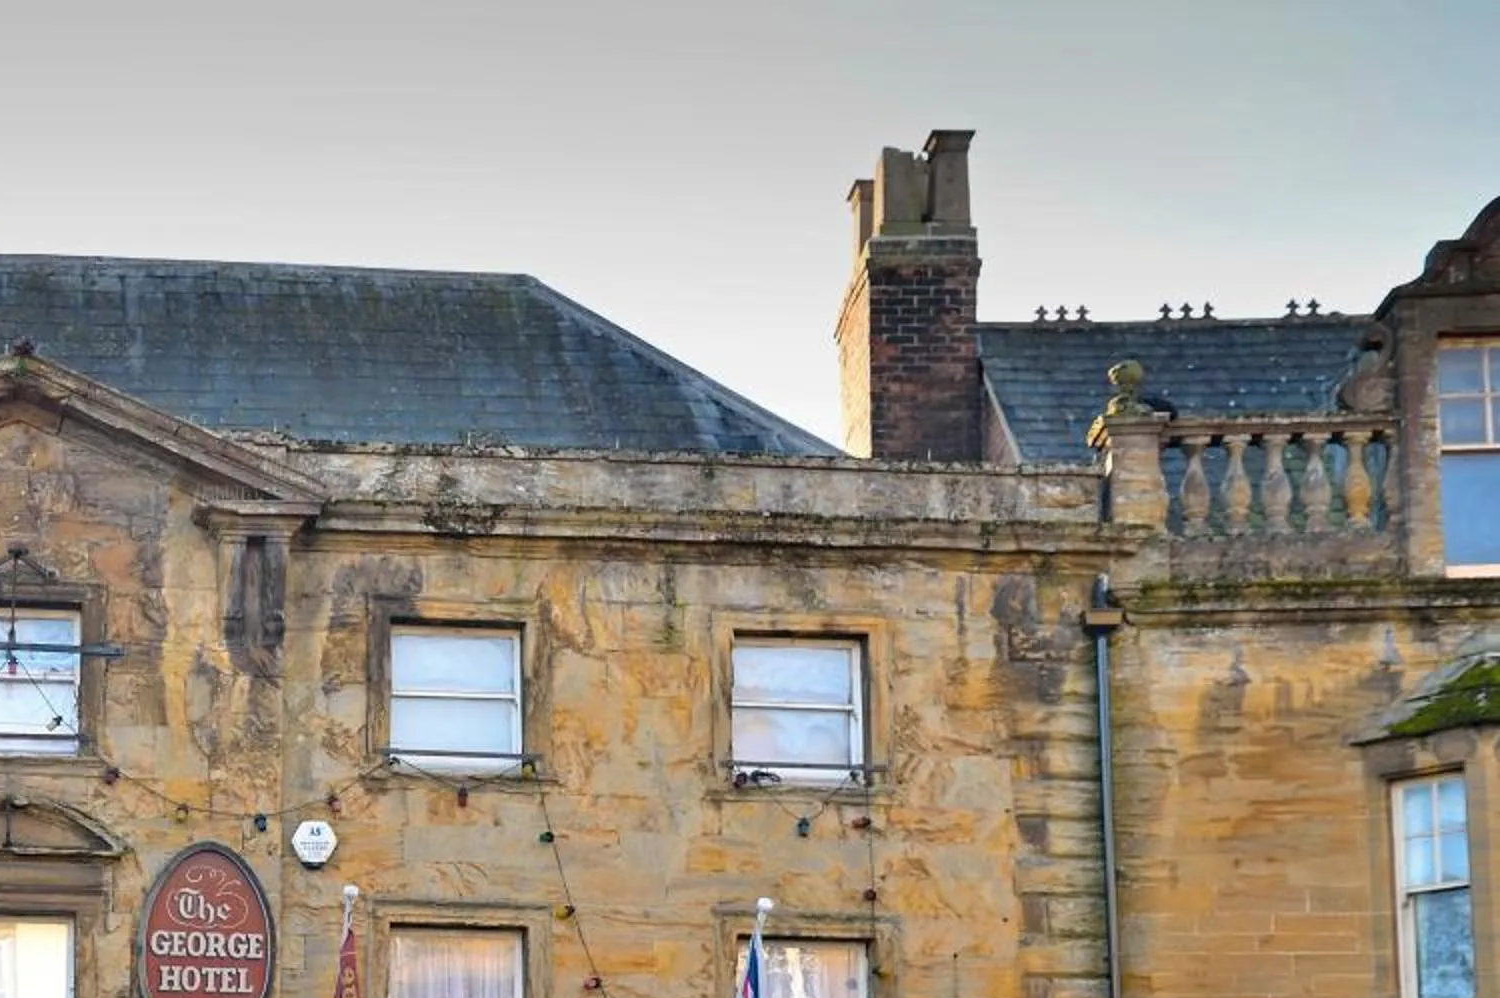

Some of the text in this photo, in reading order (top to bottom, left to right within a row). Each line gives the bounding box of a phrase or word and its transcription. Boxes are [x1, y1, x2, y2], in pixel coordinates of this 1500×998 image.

[174, 887, 232, 924] The
[150, 930, 264, 959] GEORGE
[158, 965, 253, 993] HOTEL
